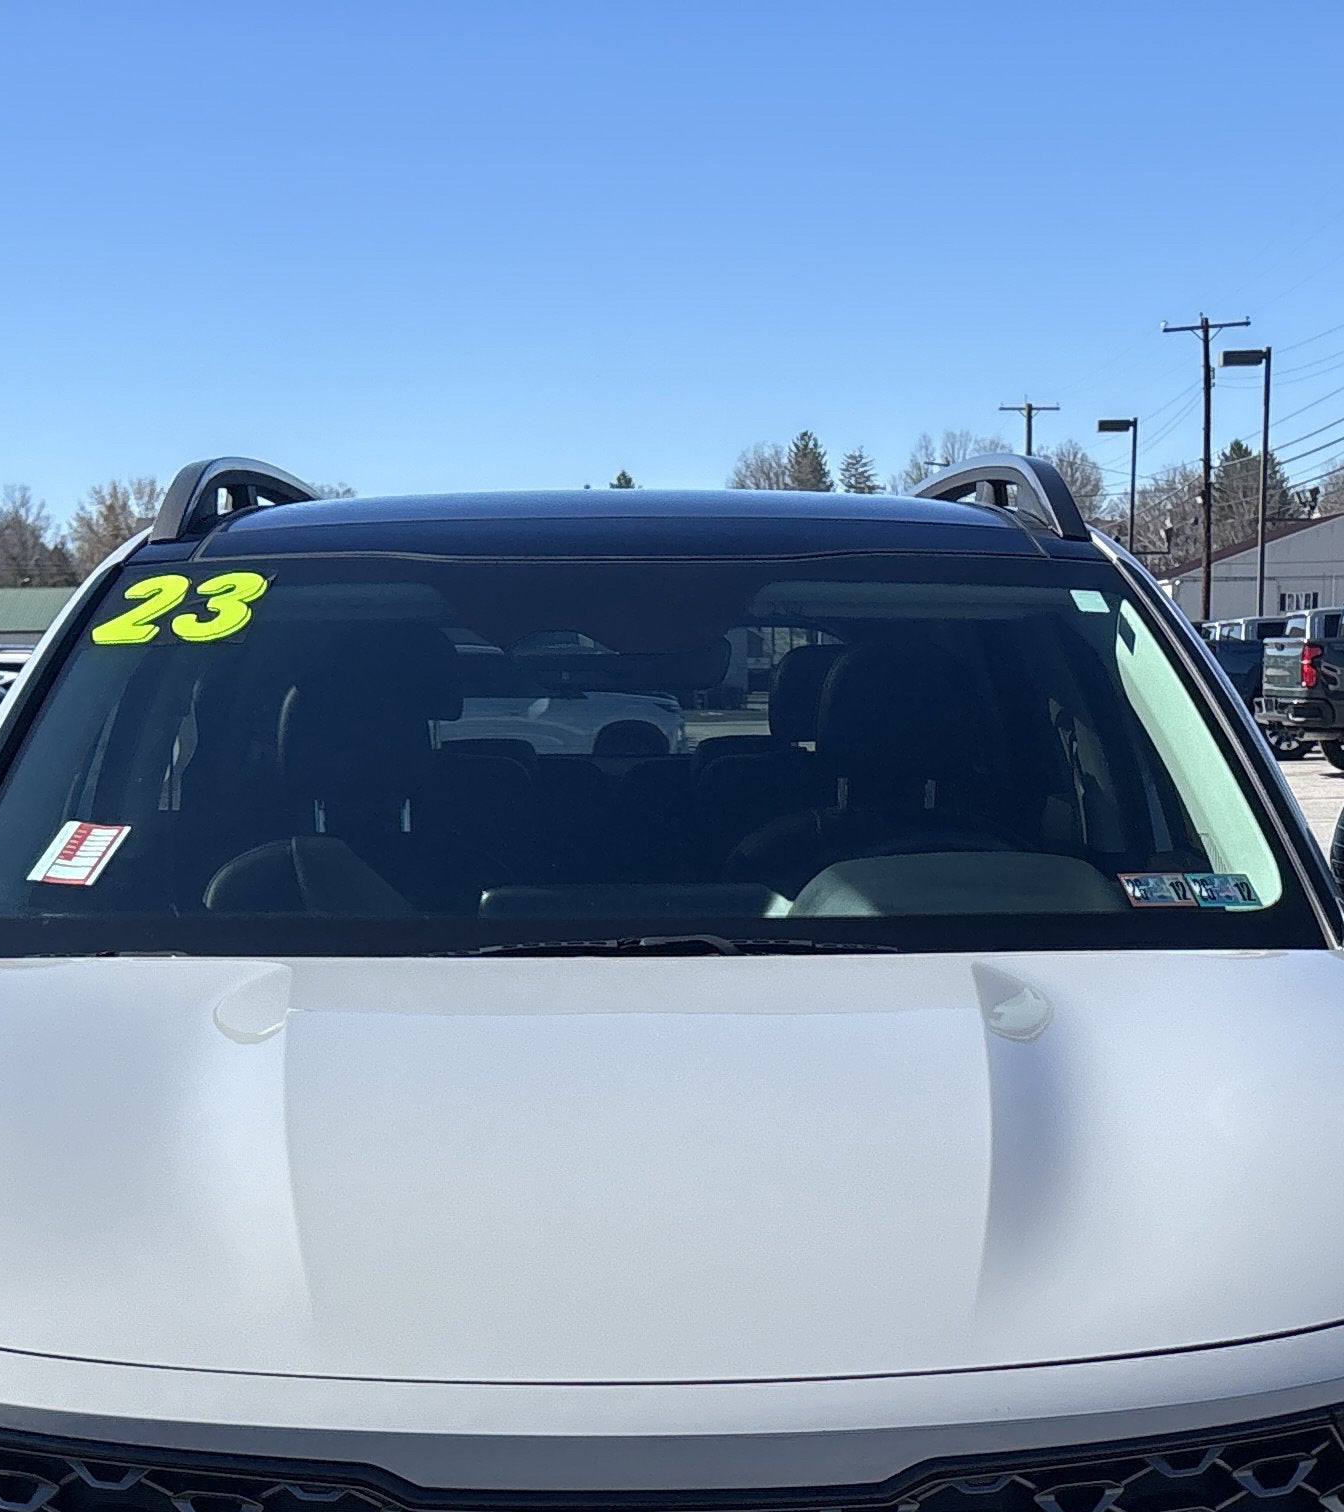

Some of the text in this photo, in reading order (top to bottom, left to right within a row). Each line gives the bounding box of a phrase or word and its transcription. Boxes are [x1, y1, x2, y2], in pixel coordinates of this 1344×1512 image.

[92, 572, 268, 645] 23
[1168, 880, 1192, 901] 12
[1233, 881, 1257, 901] 12
